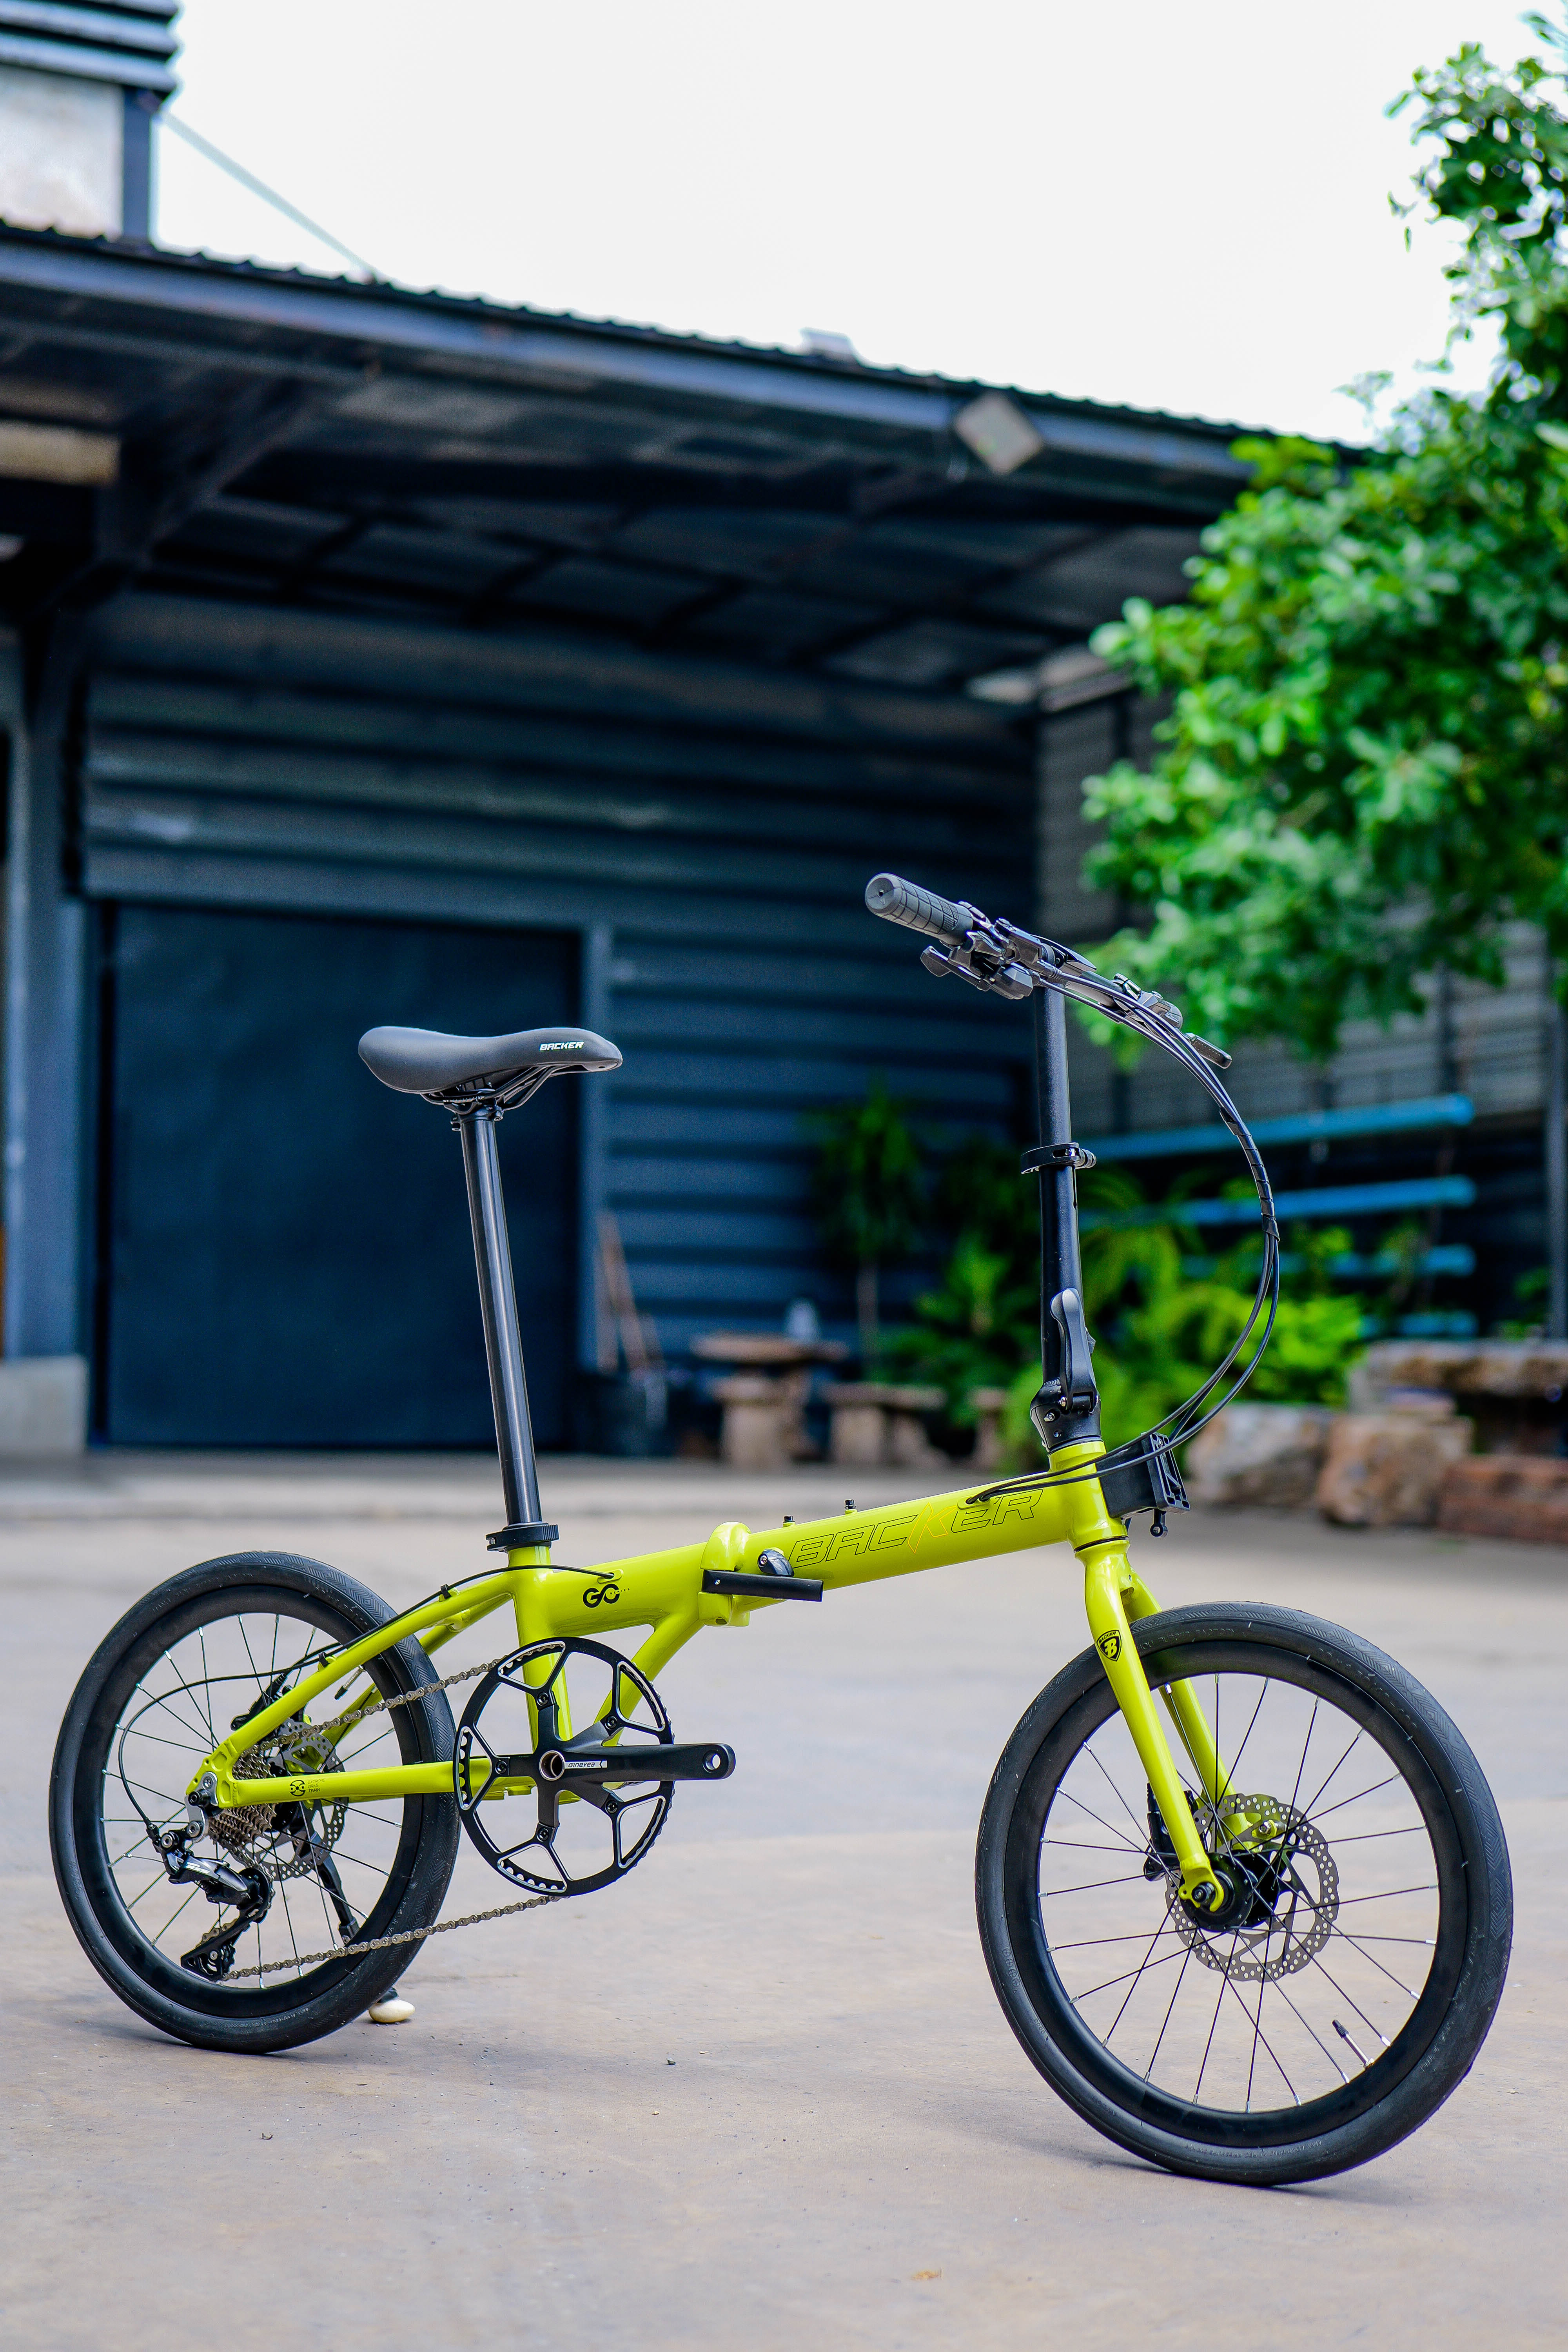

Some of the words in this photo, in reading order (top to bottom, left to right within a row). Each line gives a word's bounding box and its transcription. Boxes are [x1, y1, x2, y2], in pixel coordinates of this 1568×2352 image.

[539, 1041, 584, 1051] BACKER
[789, 1489, 1044, 1568] BACKER
[583, 1584, 620, 1608] GO
[1099, 1632, 1116, 1644] BACKER
